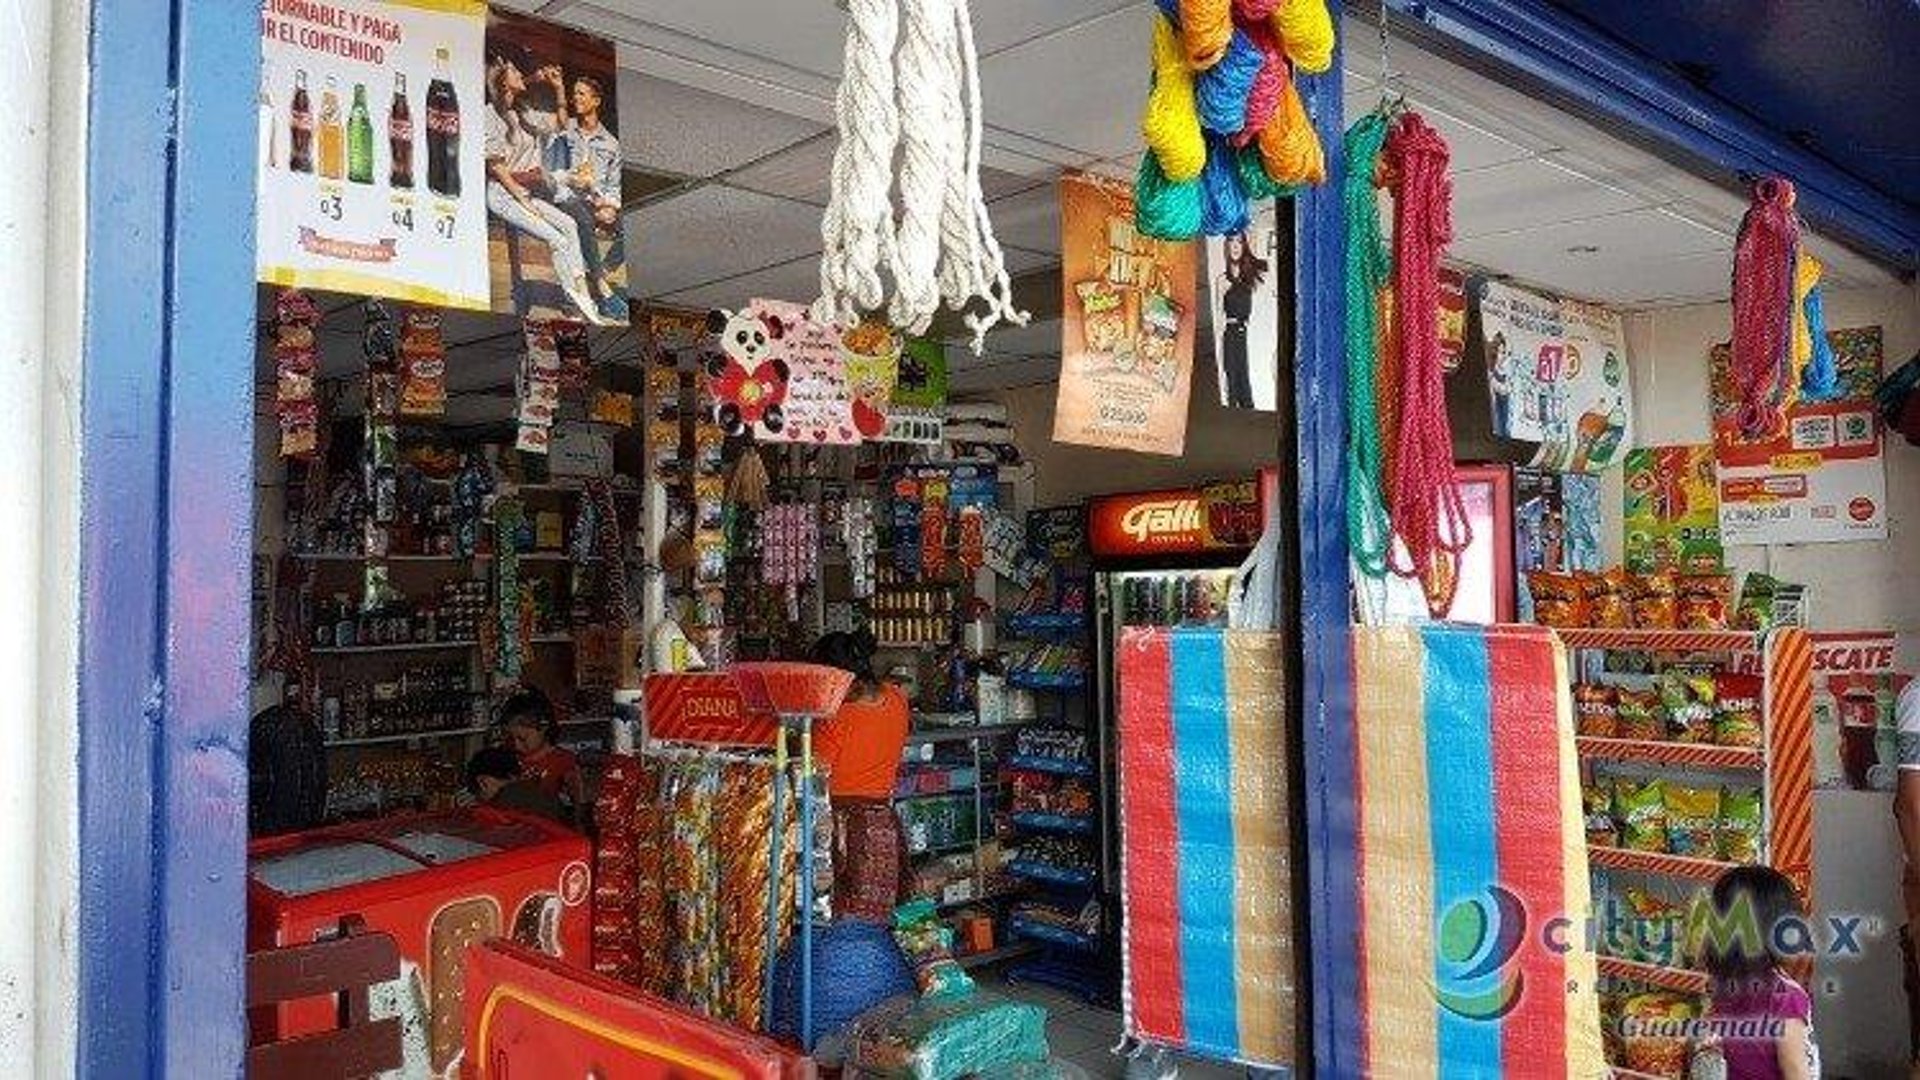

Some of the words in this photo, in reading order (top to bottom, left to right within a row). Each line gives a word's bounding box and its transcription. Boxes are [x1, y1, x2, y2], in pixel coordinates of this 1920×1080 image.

[350, 13, 360, 33] Y
[362, 17, 401, 43] PAGA
[279, 23, 297, 44] EL
[300, 28, 384, 64] CONTENIDO
[686, 697, 738, 718] DIANA
